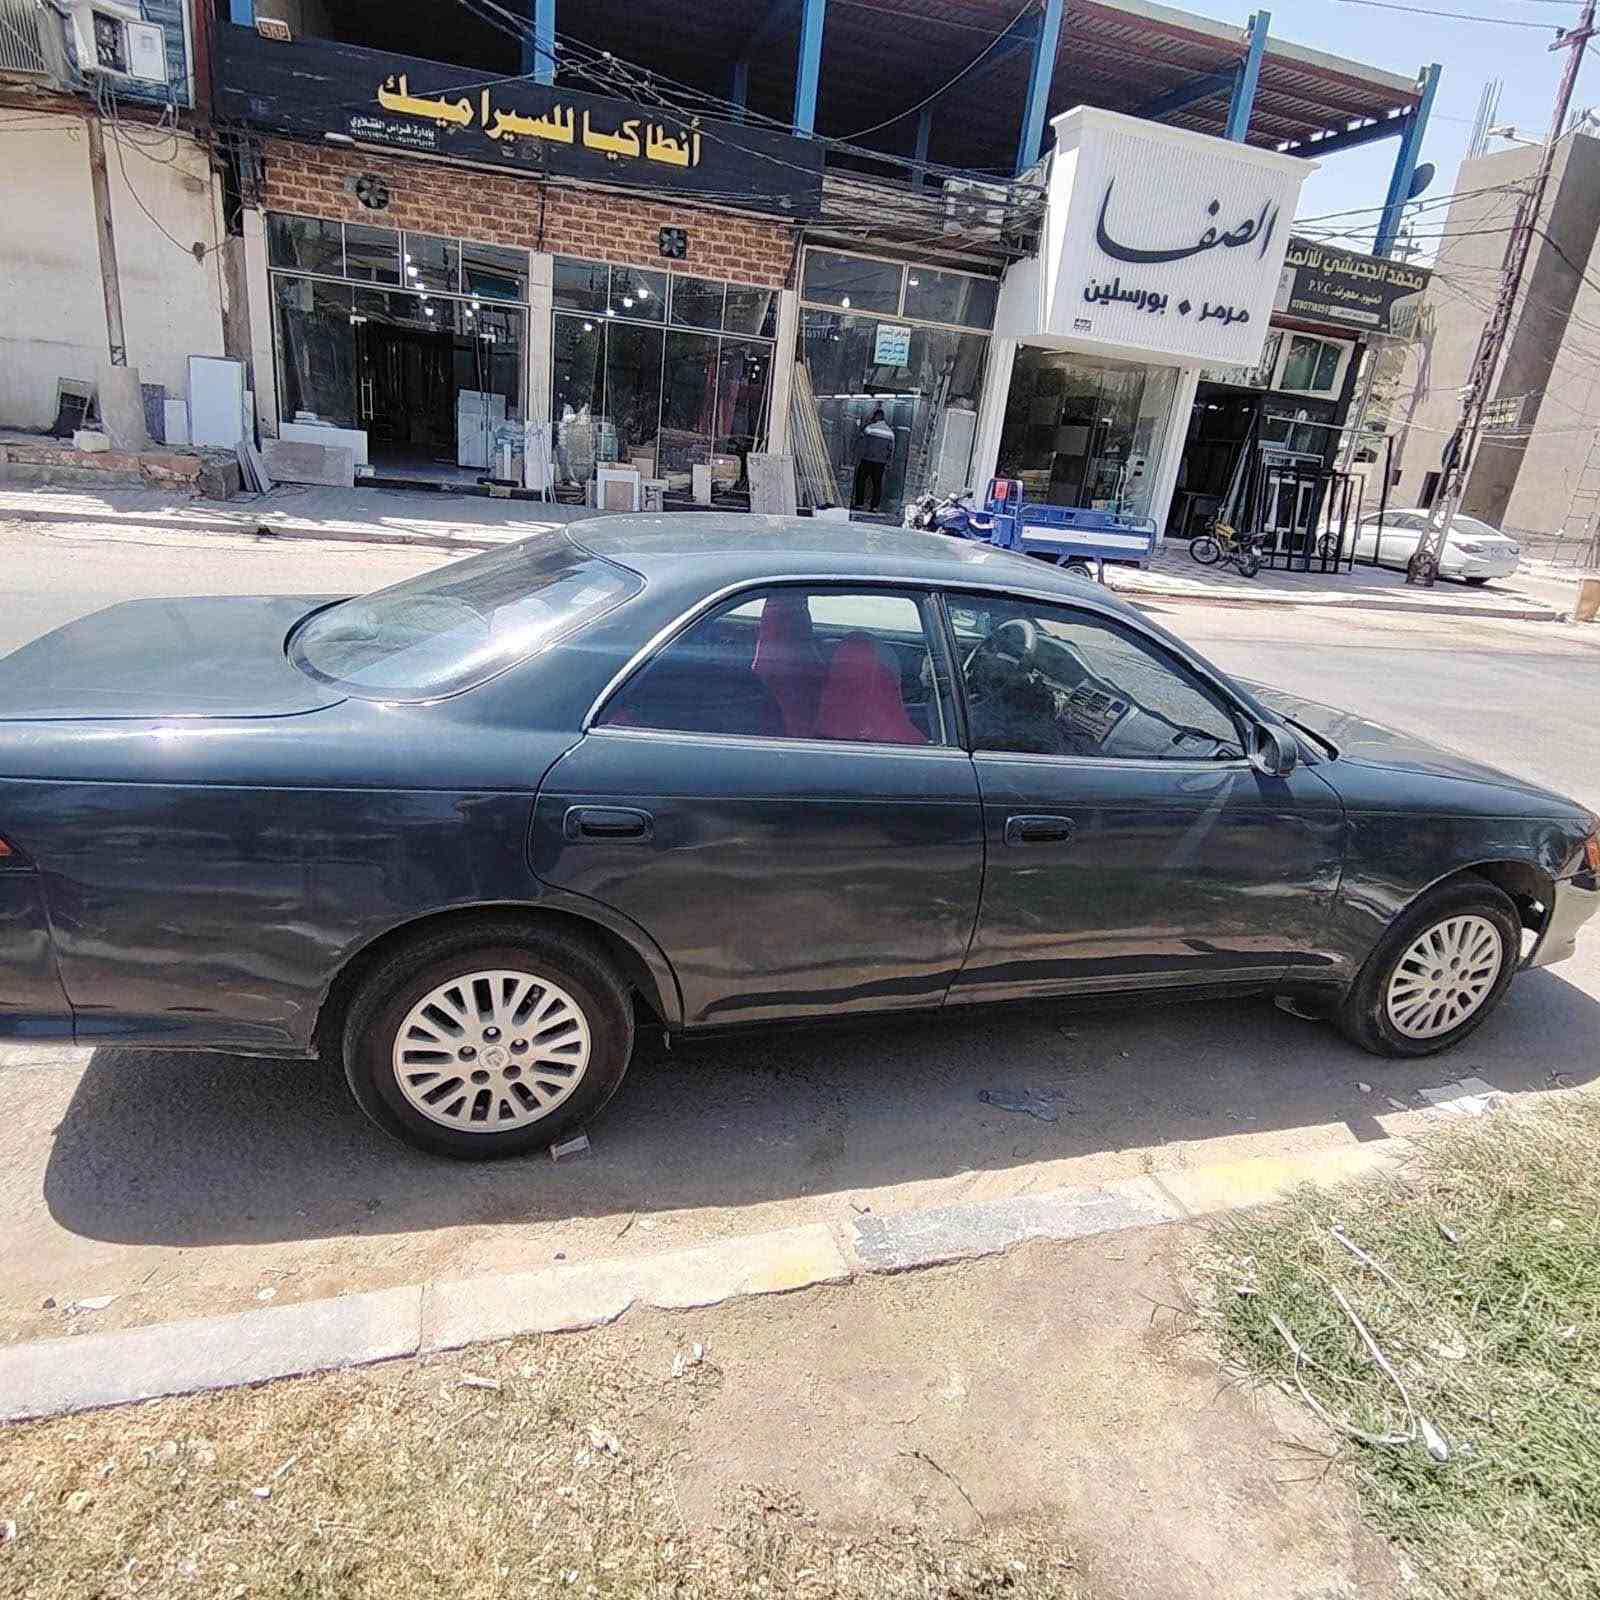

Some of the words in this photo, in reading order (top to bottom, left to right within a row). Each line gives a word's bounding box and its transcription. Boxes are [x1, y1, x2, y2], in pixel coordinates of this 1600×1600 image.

[377, 73, 574, 144] للسيراميك
[582, 112, 700, 168] أنطاكيا
[1096, 175, 1280, 263] الصفا
[1083, 277, 1168, 315] بورسلين
[1387, 266, 1424, 289] محمد
[1199, 302, 1250, 325] مرمر
